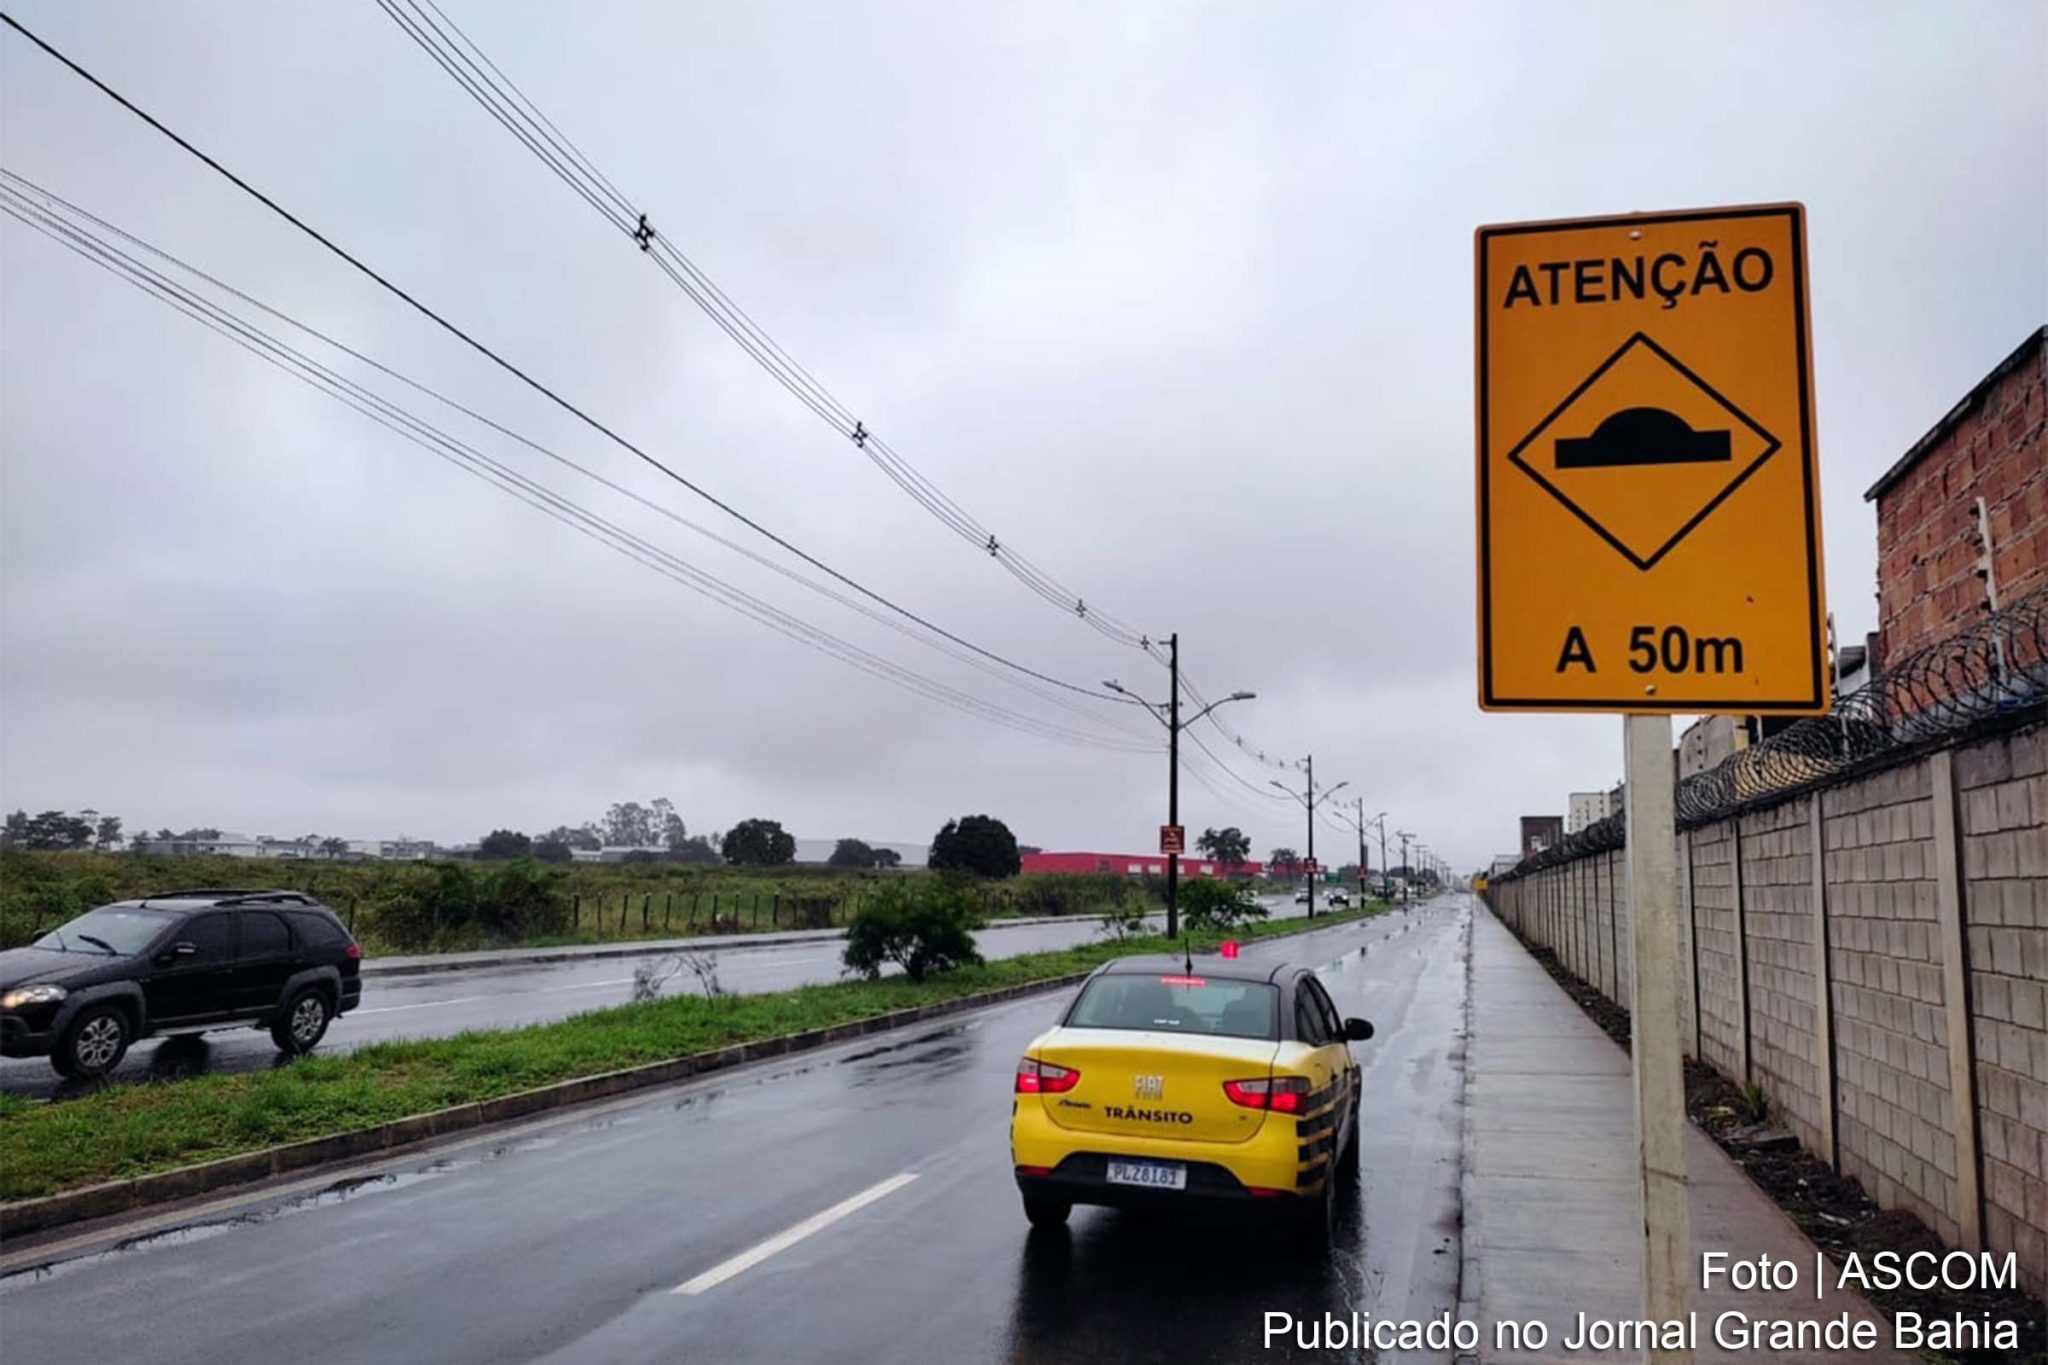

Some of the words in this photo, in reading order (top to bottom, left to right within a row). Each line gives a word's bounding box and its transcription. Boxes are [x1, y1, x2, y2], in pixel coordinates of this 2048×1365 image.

[1503, 240, 1774, 310] ATENÇÃO
[1555, 626, 1597, 673] A
[1628, 625, 1744, 674] 50m
[1104, 1104, 1194, 1125] TRÂNSITO
